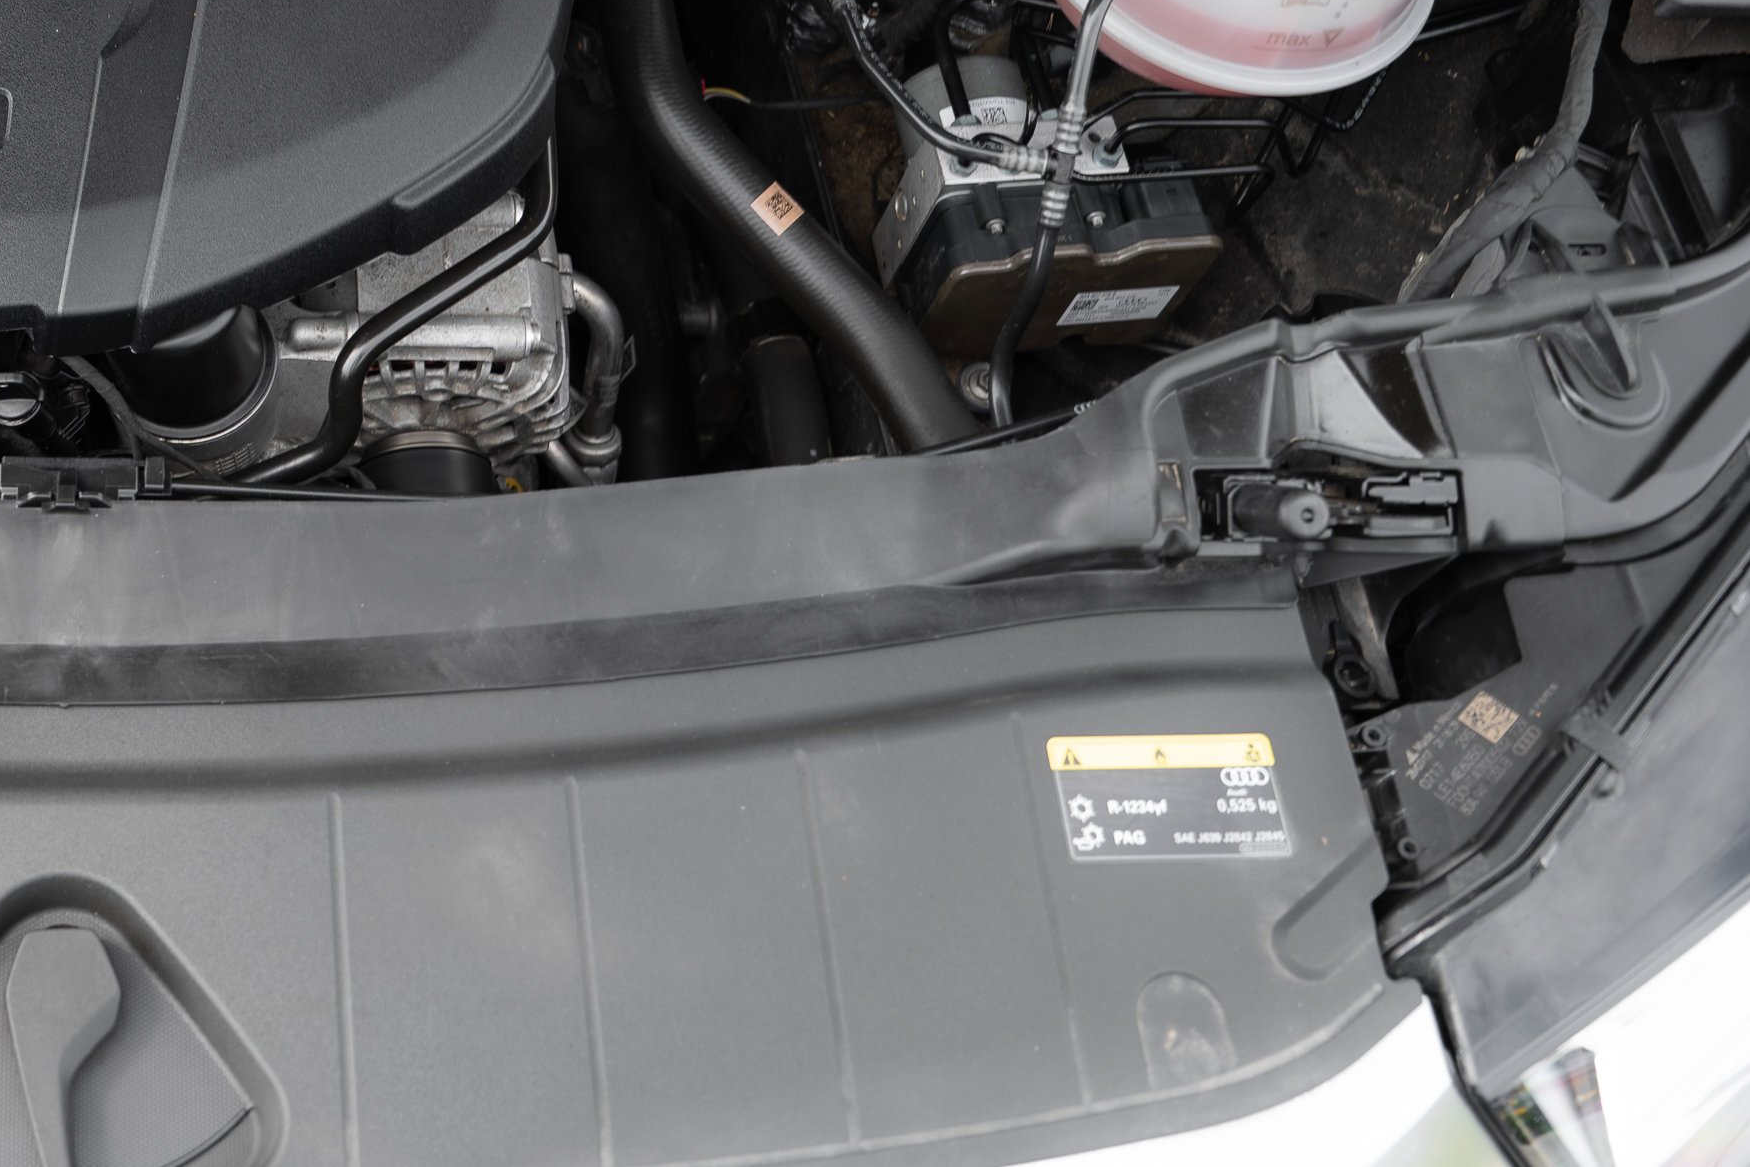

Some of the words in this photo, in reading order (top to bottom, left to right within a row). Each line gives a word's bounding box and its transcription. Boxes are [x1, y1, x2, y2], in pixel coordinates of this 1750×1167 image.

[1266, 33, 1312, 46] max
[1107, 799, 1167, 816] R-1234yf
[1217, 798, 1256, 814] 0,525
[1258, 798, 1277, 814] kg
[1113, 830, 1146, 845] PAG
[1174, 833, 1195, 844] SAE
